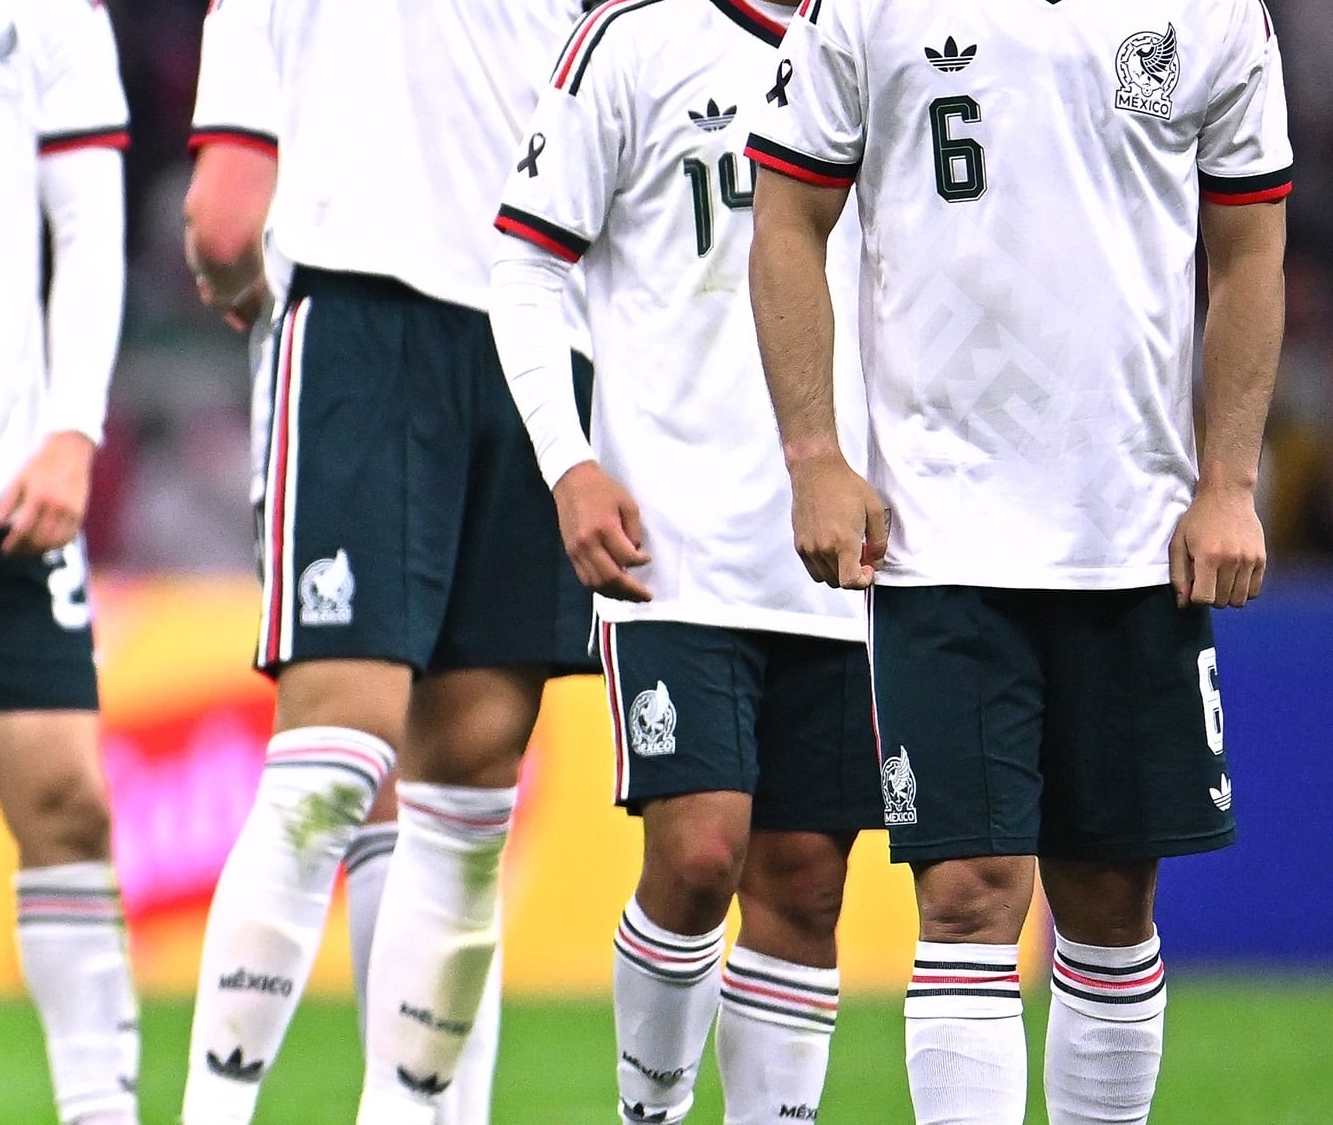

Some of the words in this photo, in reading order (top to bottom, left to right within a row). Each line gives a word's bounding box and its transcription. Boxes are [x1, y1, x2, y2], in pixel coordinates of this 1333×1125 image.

[928, 94, 989, 204] 6
[1119, 93, 1169, 115] MÉXICO
[1197, 646, 1224, 755] 6
